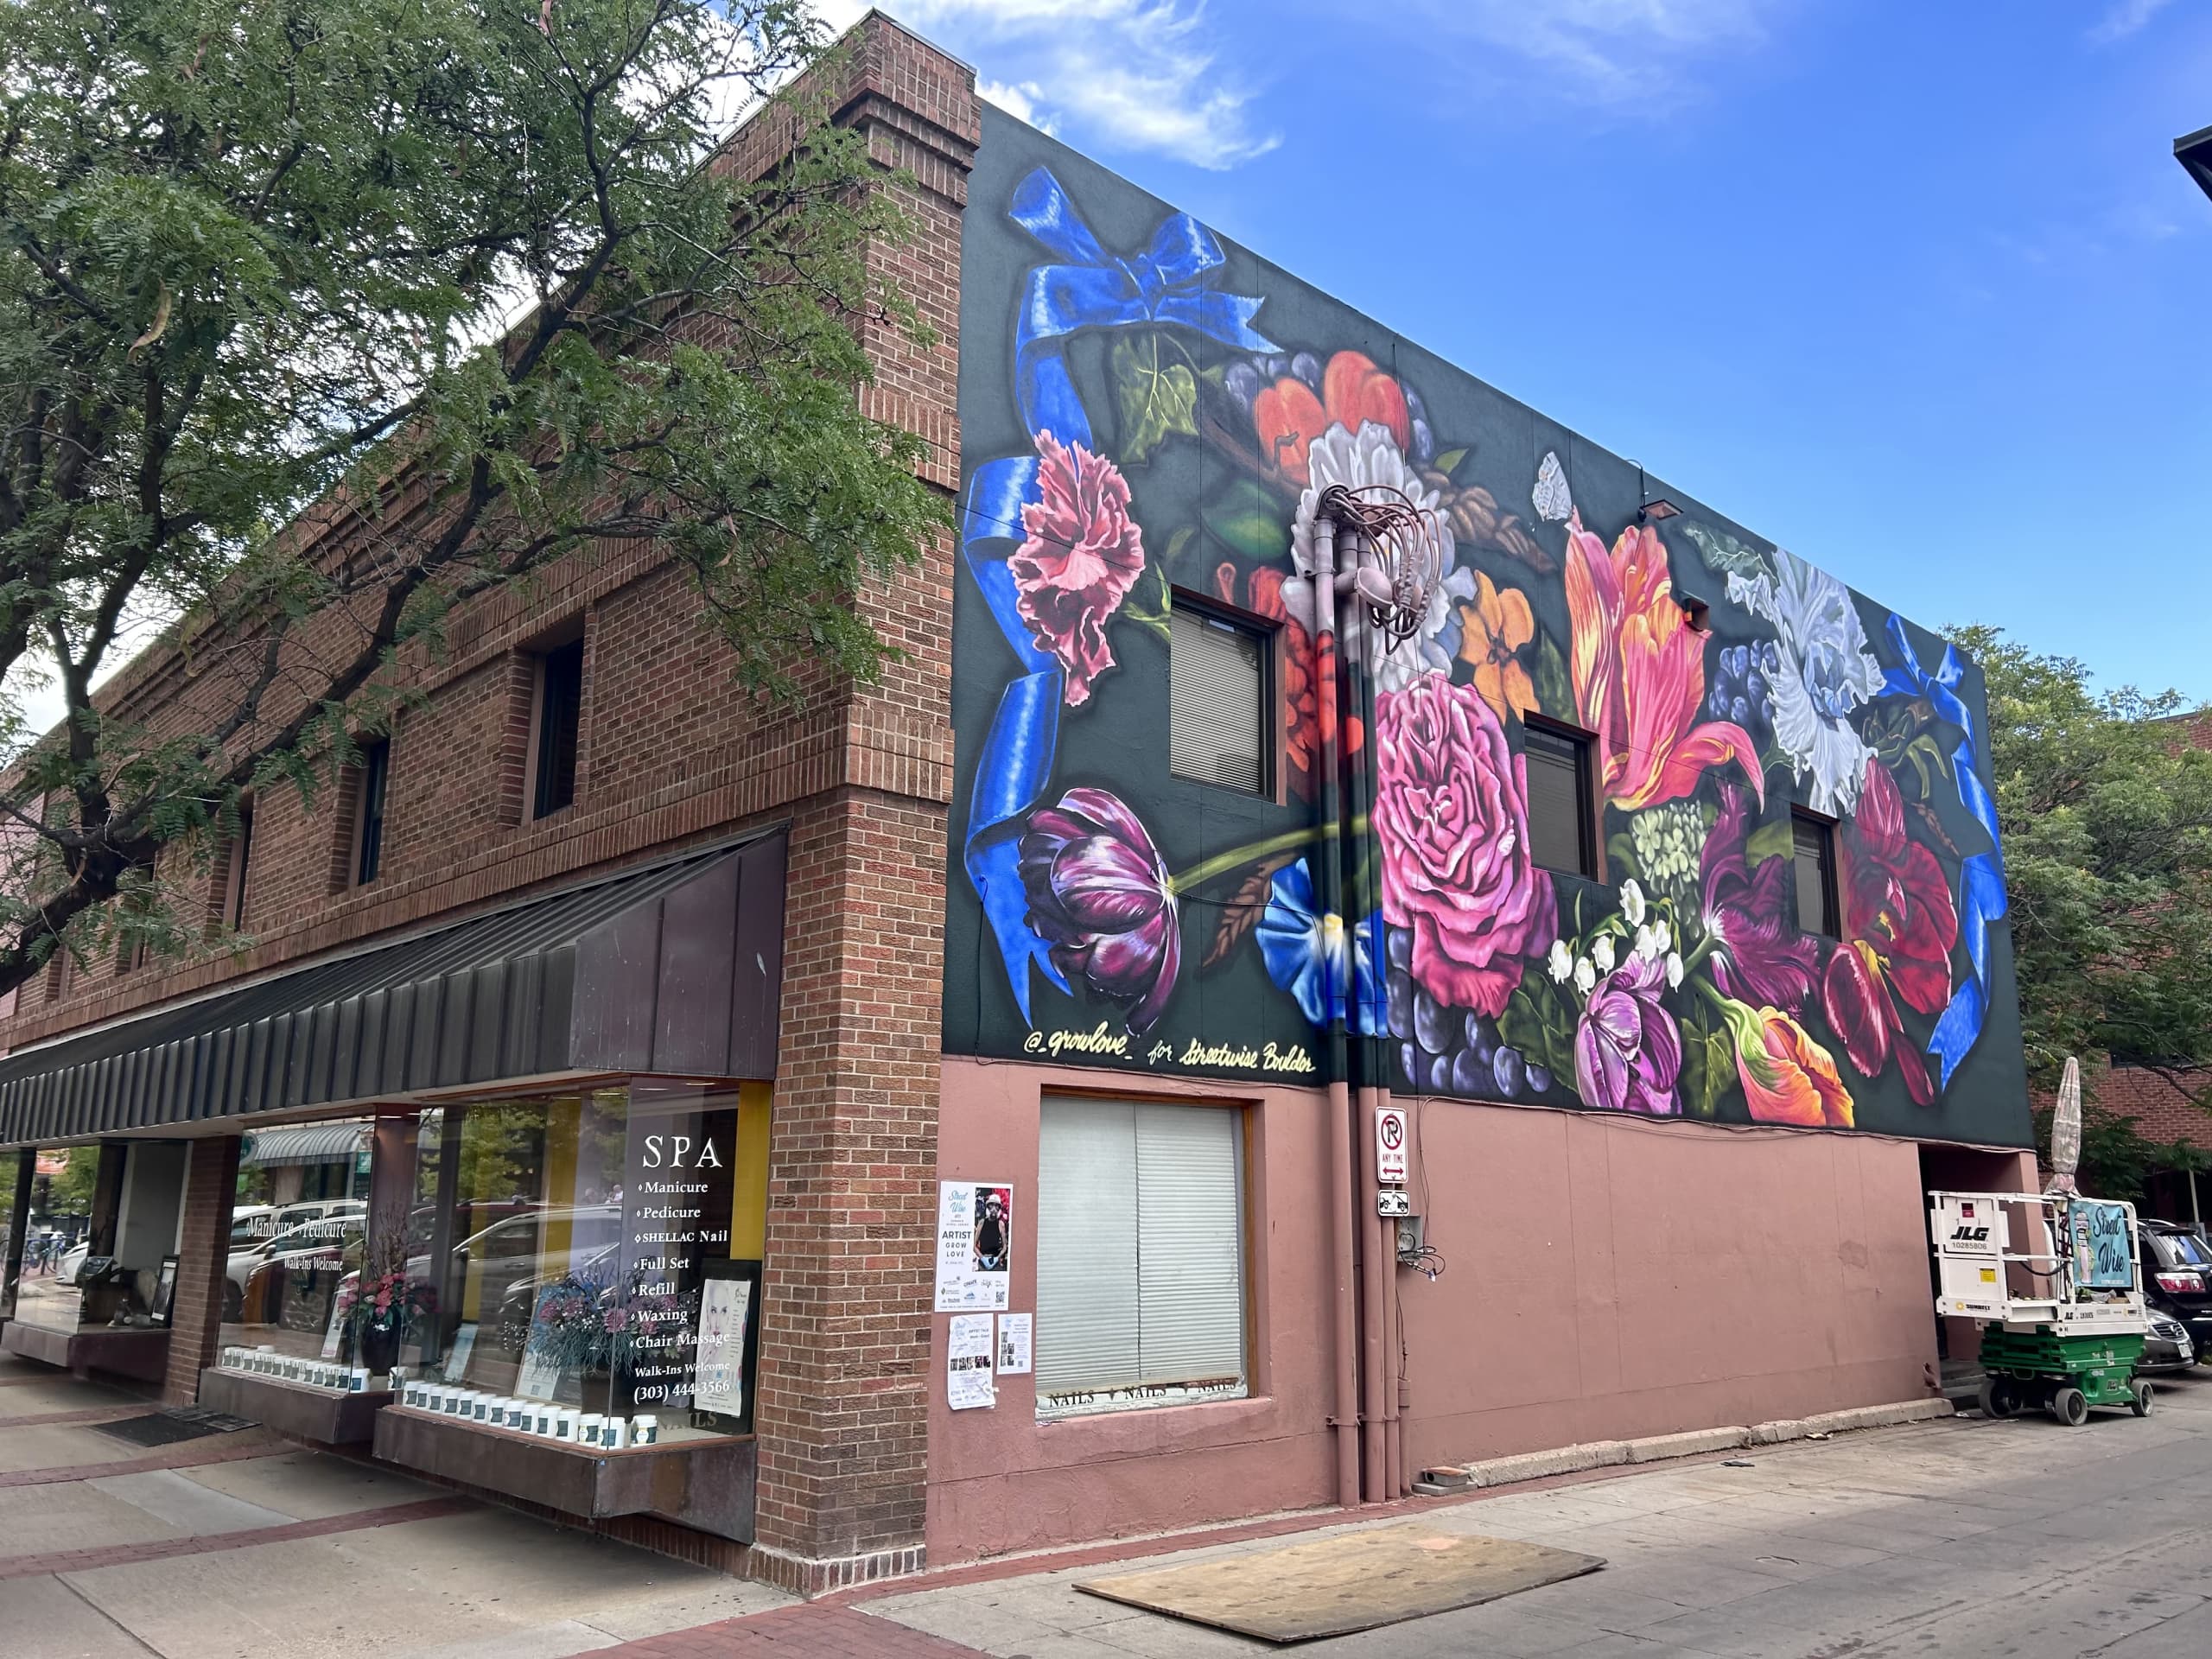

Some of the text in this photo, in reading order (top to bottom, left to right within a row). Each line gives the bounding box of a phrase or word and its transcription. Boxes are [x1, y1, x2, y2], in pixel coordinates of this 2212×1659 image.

[1147, 1039, 1172, 1065] for
[1179, 1037, 1258, 1069] Streetwise
[1263, 1041, 1316, 1073] Boulder
[643, 1135, 723, 1167] SPA
[1394, 1154, 1403, 1163] TIME
[644, 1180, 709, 1193] Manicure
[643, 1205, 701, 1218] Pedicure
[247, 1217, 346, 1238] Manicure Pedicure
[2094, 1206, 2121, 1237] Street
[642, 1230, 728, 1243] SHELLAC Nail
[942, 1230, 971, 1239] ARTIST
[1950, 1226, 1990, 1241] JLG
[284, 1255, 344, 1271] Walk-Ins Welcome
[639, 1256, 690, 1270] Full Set
[2098, 1239, 2124, 1274] Wise
[639, 1282, 675, 1296] Refill
[638, 1308, 688, 1324] Waxing
[636, 1333, 730, 1349] Chair Massage
[635, 1362, 730, 1377] Walk-Ins Welcome
[633, 1380, 730, 1405] (303) 444-3566
[1050, 1389, 1094, 1408] NAILS
[1125, 1383, 1166, 1400] NAILS
